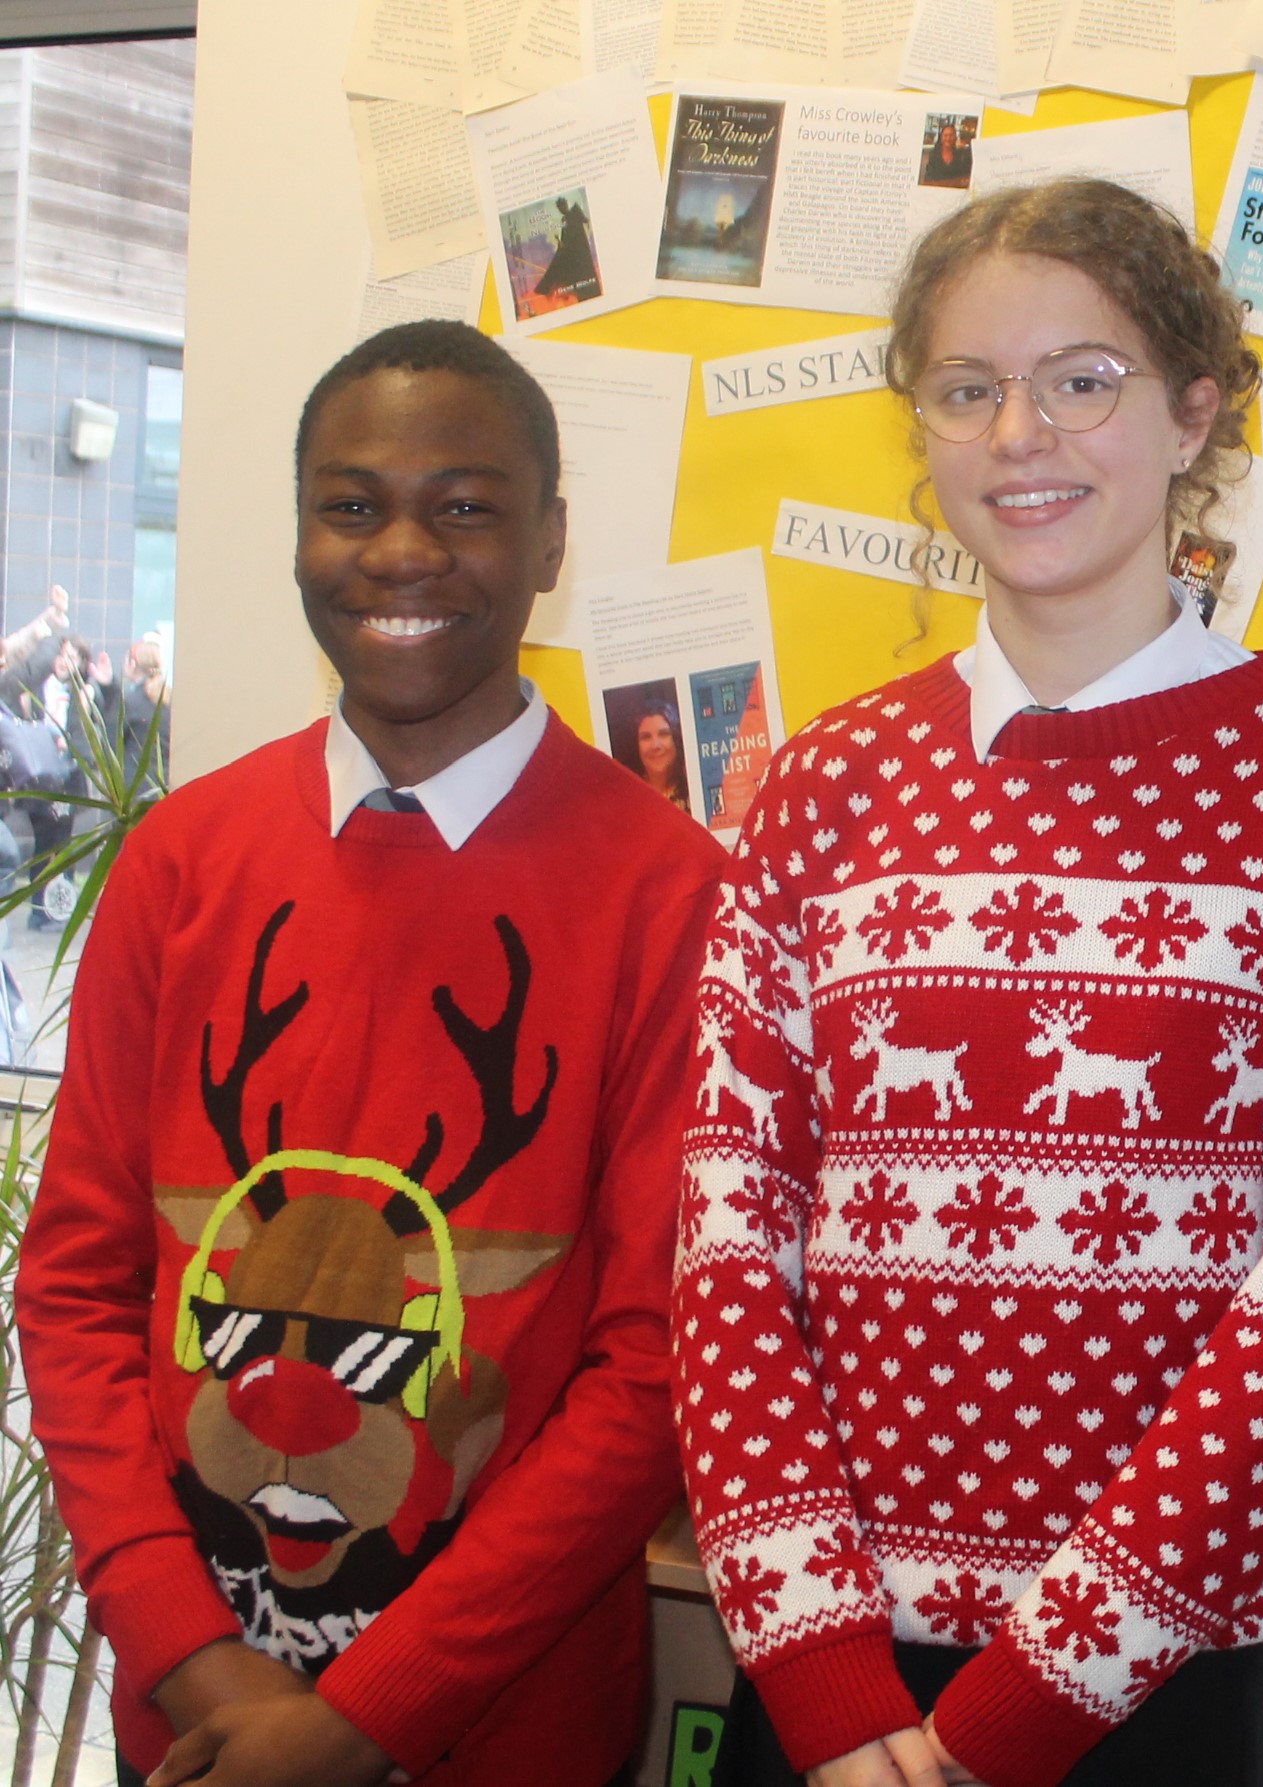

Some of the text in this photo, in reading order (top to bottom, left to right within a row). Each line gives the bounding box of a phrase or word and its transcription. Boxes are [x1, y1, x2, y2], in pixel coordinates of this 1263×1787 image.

[694, 103, 767, 122] Harry Thompson
[800, 105, 903, 128] Miss Crowley's
[687, 118, 713, 141] This
[720, 120, 757, 146] Thing
[797, 124, 900, 147] favourite book
[1247, 249, 1262, 264] Why
[713, 361, 786, 404] NLS
[701, 733, 767, 759] READING
[722, 755, 751, 775] LIST
